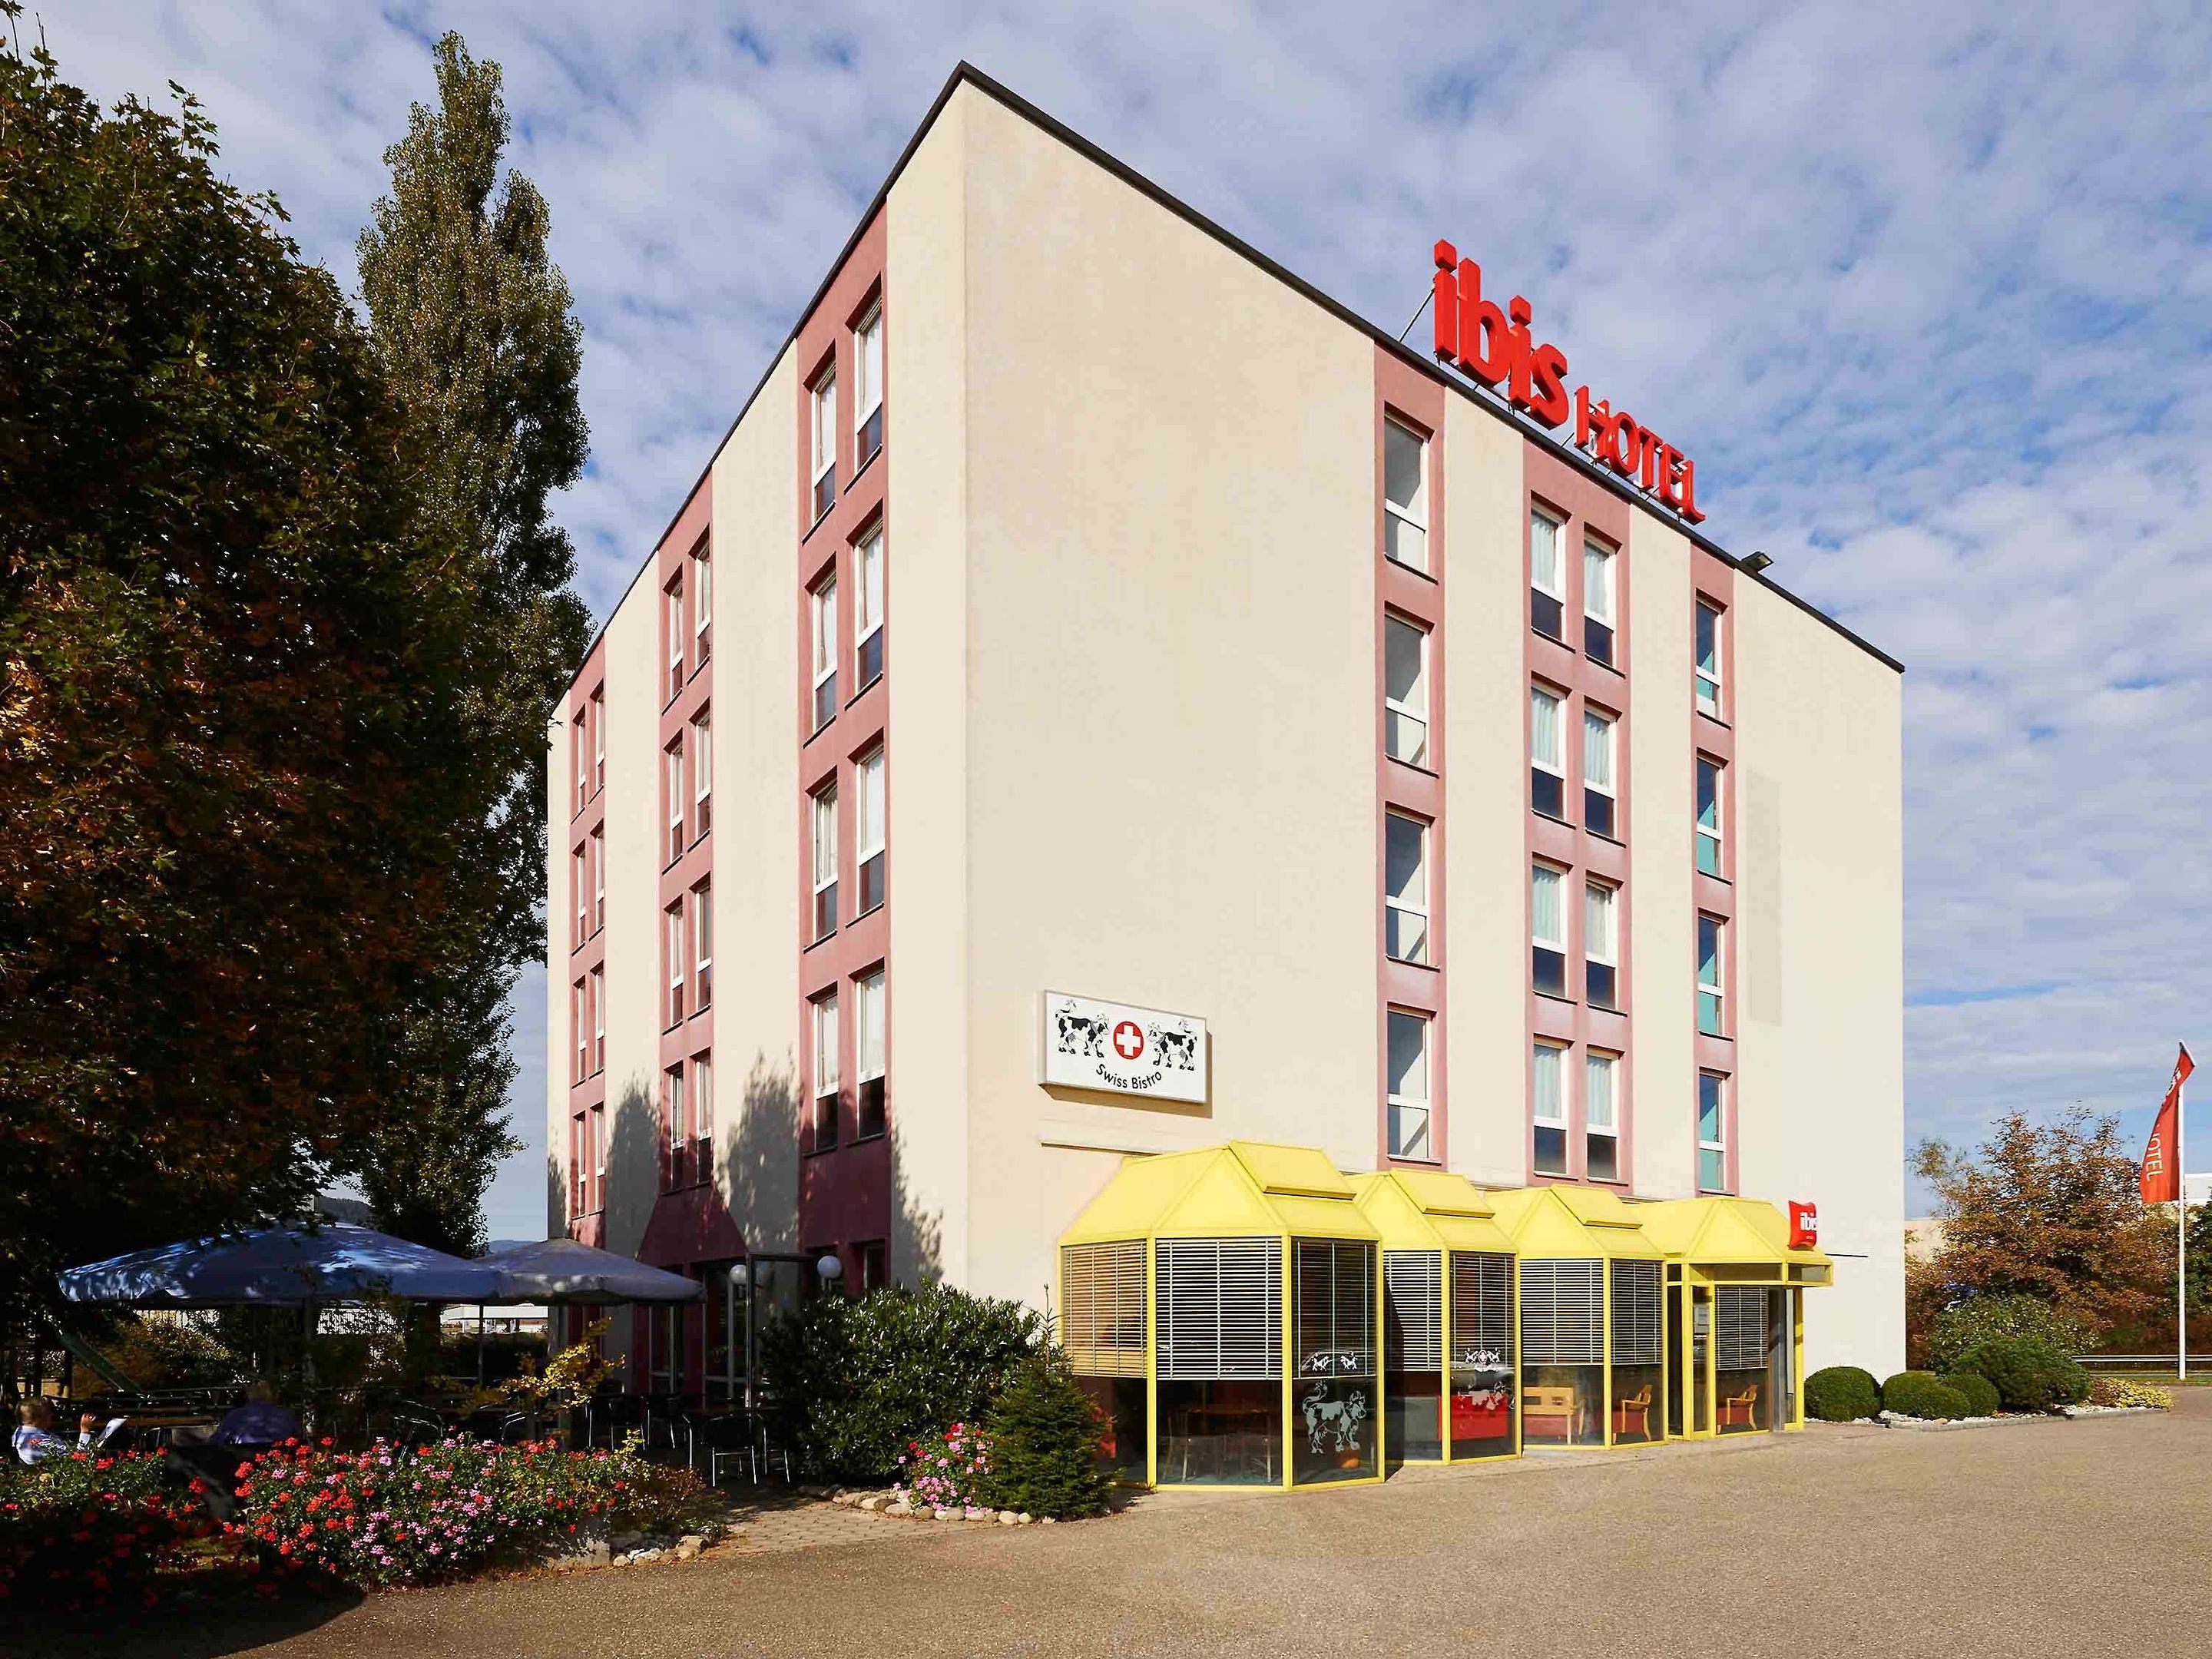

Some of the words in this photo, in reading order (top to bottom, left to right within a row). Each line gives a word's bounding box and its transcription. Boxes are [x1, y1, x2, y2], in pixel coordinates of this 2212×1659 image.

[1433, 239, 1569, 430] ibis
[1574, 385, 1707, 525] HOTEL
[1096, 1064, 1128, 1088] Swiss
[1131, 1071, 1162, 1089] Bistro
